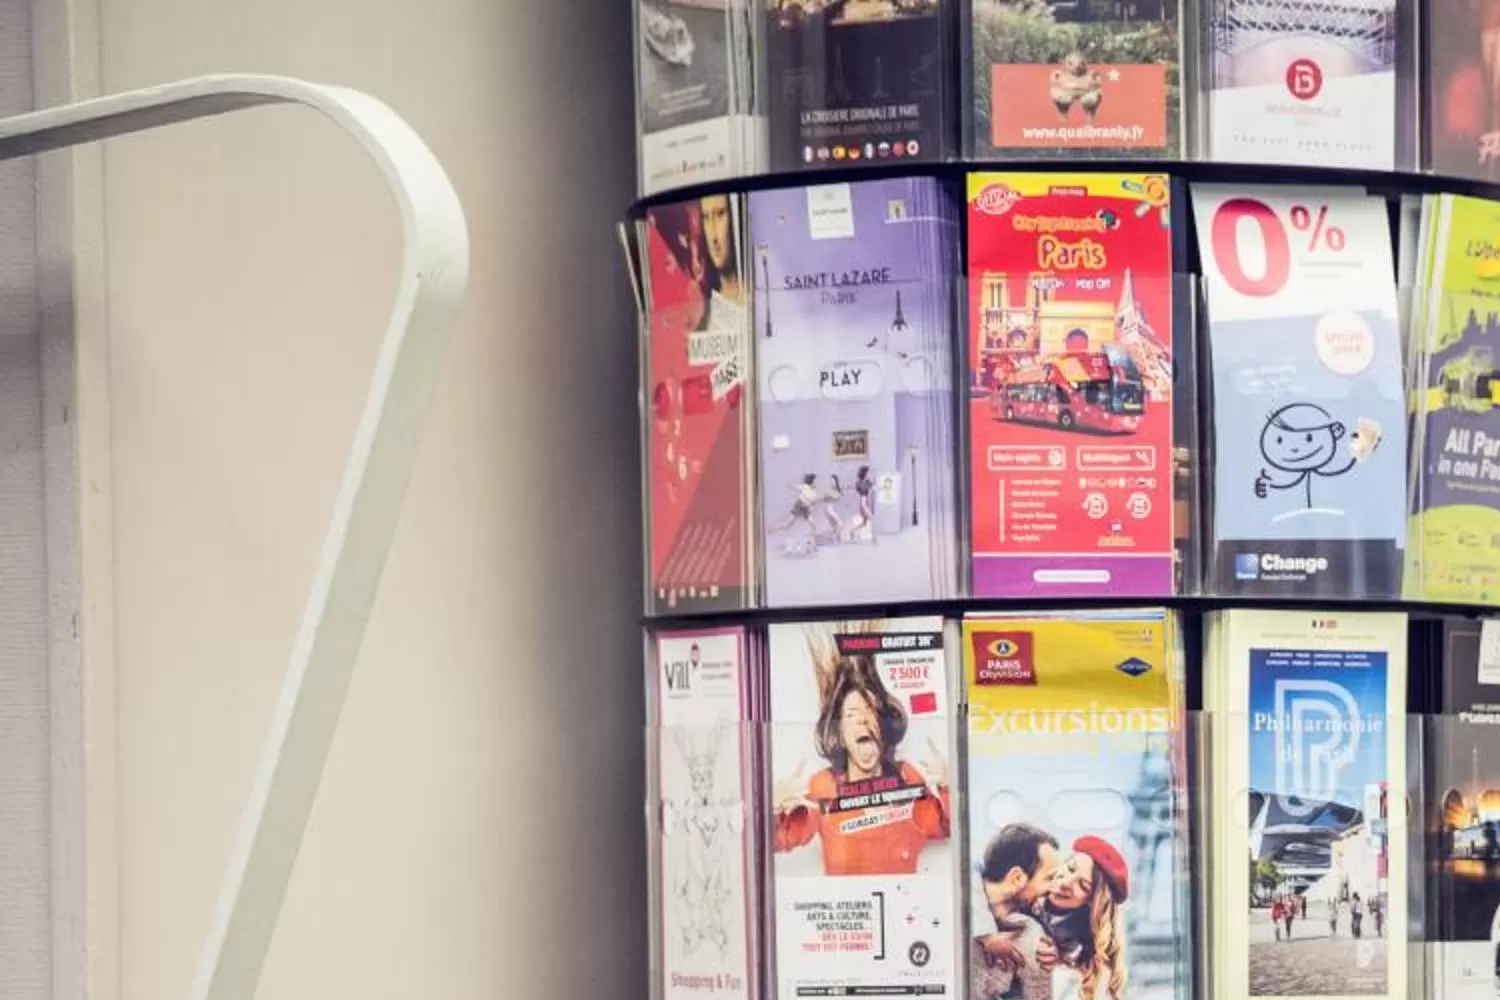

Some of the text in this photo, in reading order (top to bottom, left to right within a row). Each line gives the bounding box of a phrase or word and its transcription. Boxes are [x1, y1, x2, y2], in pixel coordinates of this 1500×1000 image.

[1039, 236, 1106, 268] Paris
[1211, 197, 1346, 298] 0%
[784, 266, 892, 290] SAINT LAZARE
[819, 369, 862, 387] PLAY
[1444, 428, 1471, 455] All
[1437, 454, 1452, 475] in
[1453, 459, 1477, 477] one
[1261, 553, 1329, 574] Change
[988, 659, 1021, 670] PARIS
[969, 701, 1169, 735] Excursions
[1253, 711, 1383, 733] Philharmonie
[806, 911, 827, 921] ARTS
